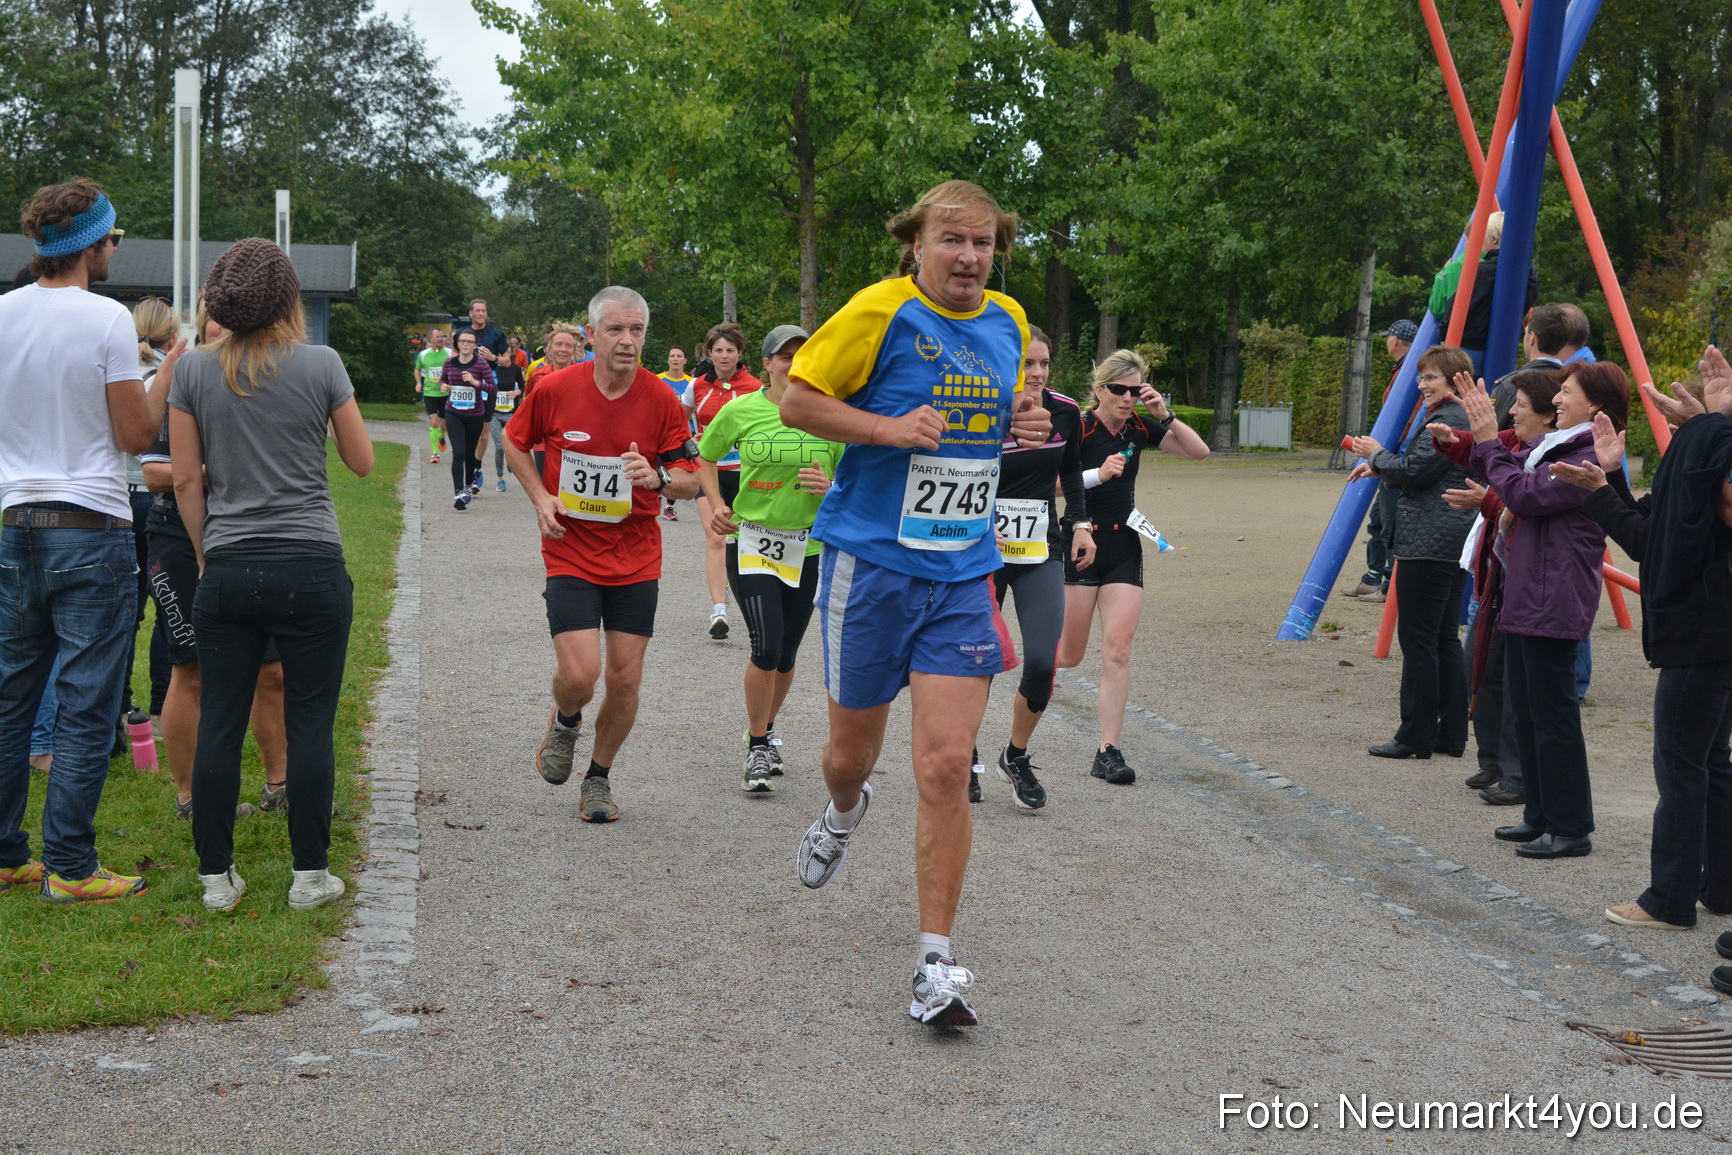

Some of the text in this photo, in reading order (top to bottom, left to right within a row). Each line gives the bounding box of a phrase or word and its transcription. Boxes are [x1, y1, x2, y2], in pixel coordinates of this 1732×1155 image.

[452, 391, 473, 400] 2900
[497, 396, 509, 404] 108
[563, 454, 622, 470] PARTL Neumarkt
[911, 464, 989, 478] PARTL Neumarkt
[573, 469, 619, 498] 314
[748, 481, 782, 490] MERZ
[914, 480, 990, 514] 2743
[579, 500, 607, 513] Claus
[742, 522, 796, 540] PARTL Neumarkt
[930, 524, 968, 538] Achim
[998, 514, 1038, 538] 217
[758, 538, 785, 560] 23
